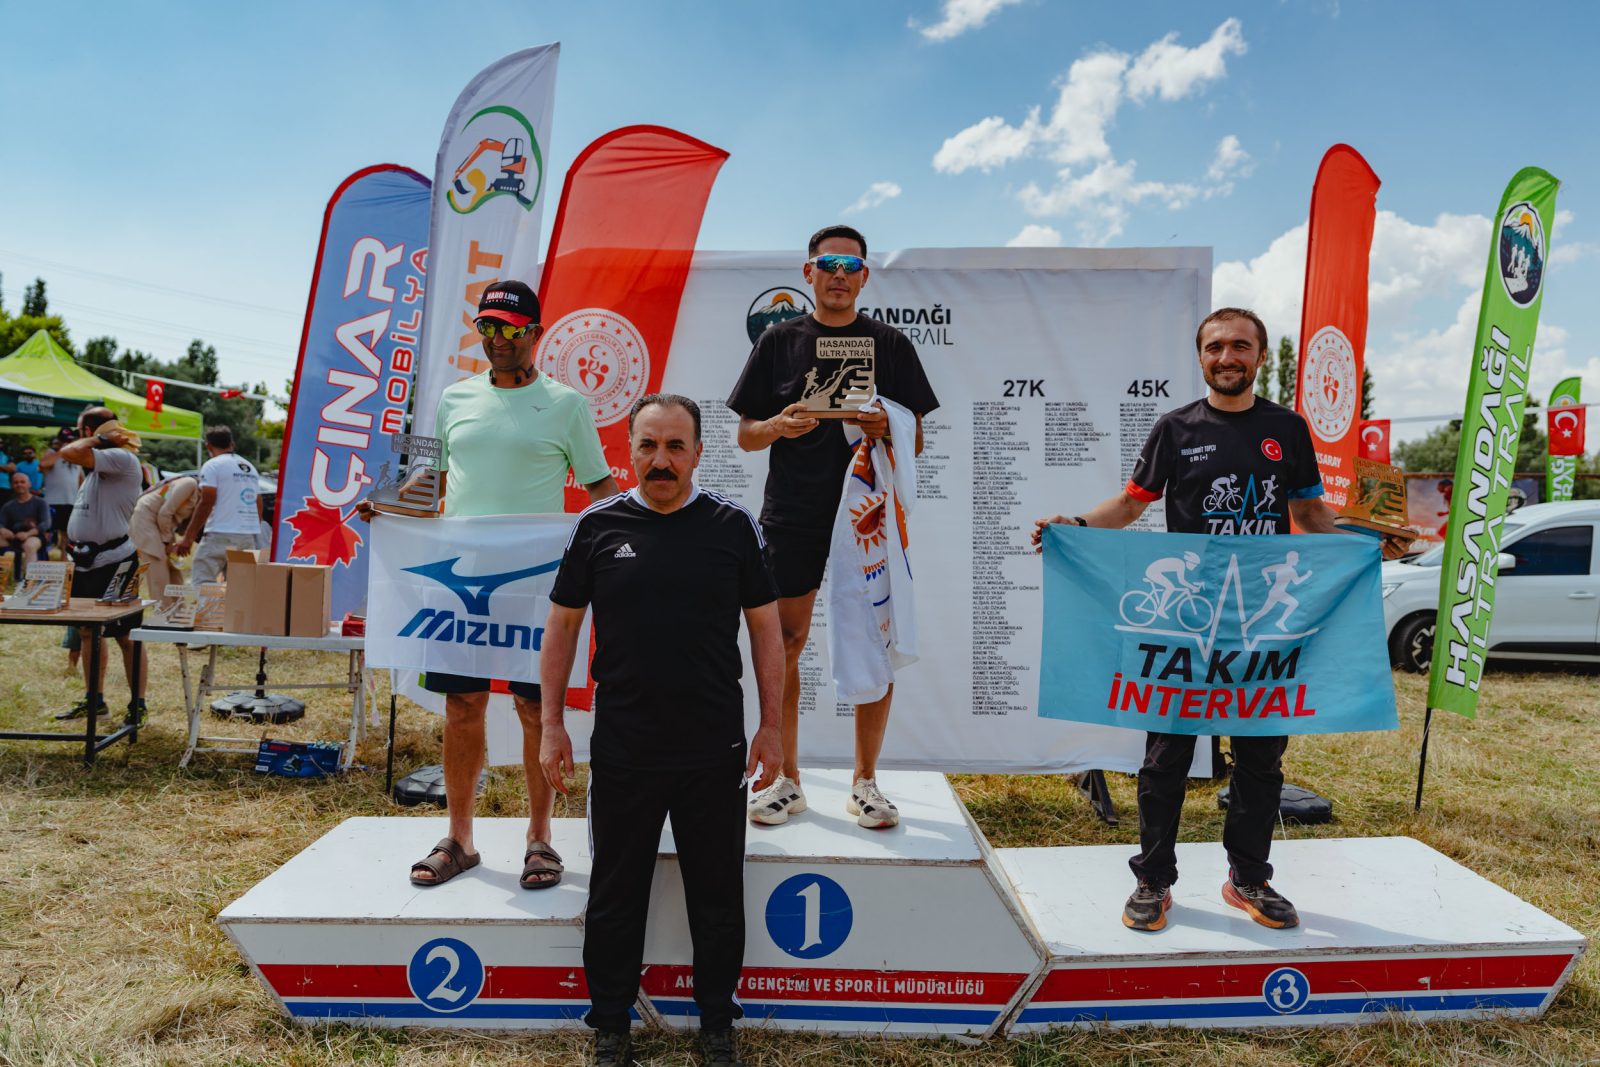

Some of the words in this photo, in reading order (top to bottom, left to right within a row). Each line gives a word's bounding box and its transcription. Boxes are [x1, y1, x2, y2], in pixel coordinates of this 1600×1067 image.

[859, 304, 951, 325] SANDAĞI
[819, 339, 873, 348] HASANDAĞI
[1003, 380, 1045, 397] 27K
[1127, 380, 1170, 397] 45K
[1493, 344, 1531, 495] TRAIL
[1446, 325, 1511, 688] HASANDAĞI
[614, 551, 636, 559] adidas
[1107, 673, 1316, 719] İNTERVAL
[796, 882, 821, 951] 1
[424, 947, 467, 1002] 2
[814, 979, 830, 992] VE
[834, 979, 873, 993] SPOR
[894, 978, 984, 996] MÜDÜRLÜĞÜ
[1271, 972, 1299, 1009] 3
